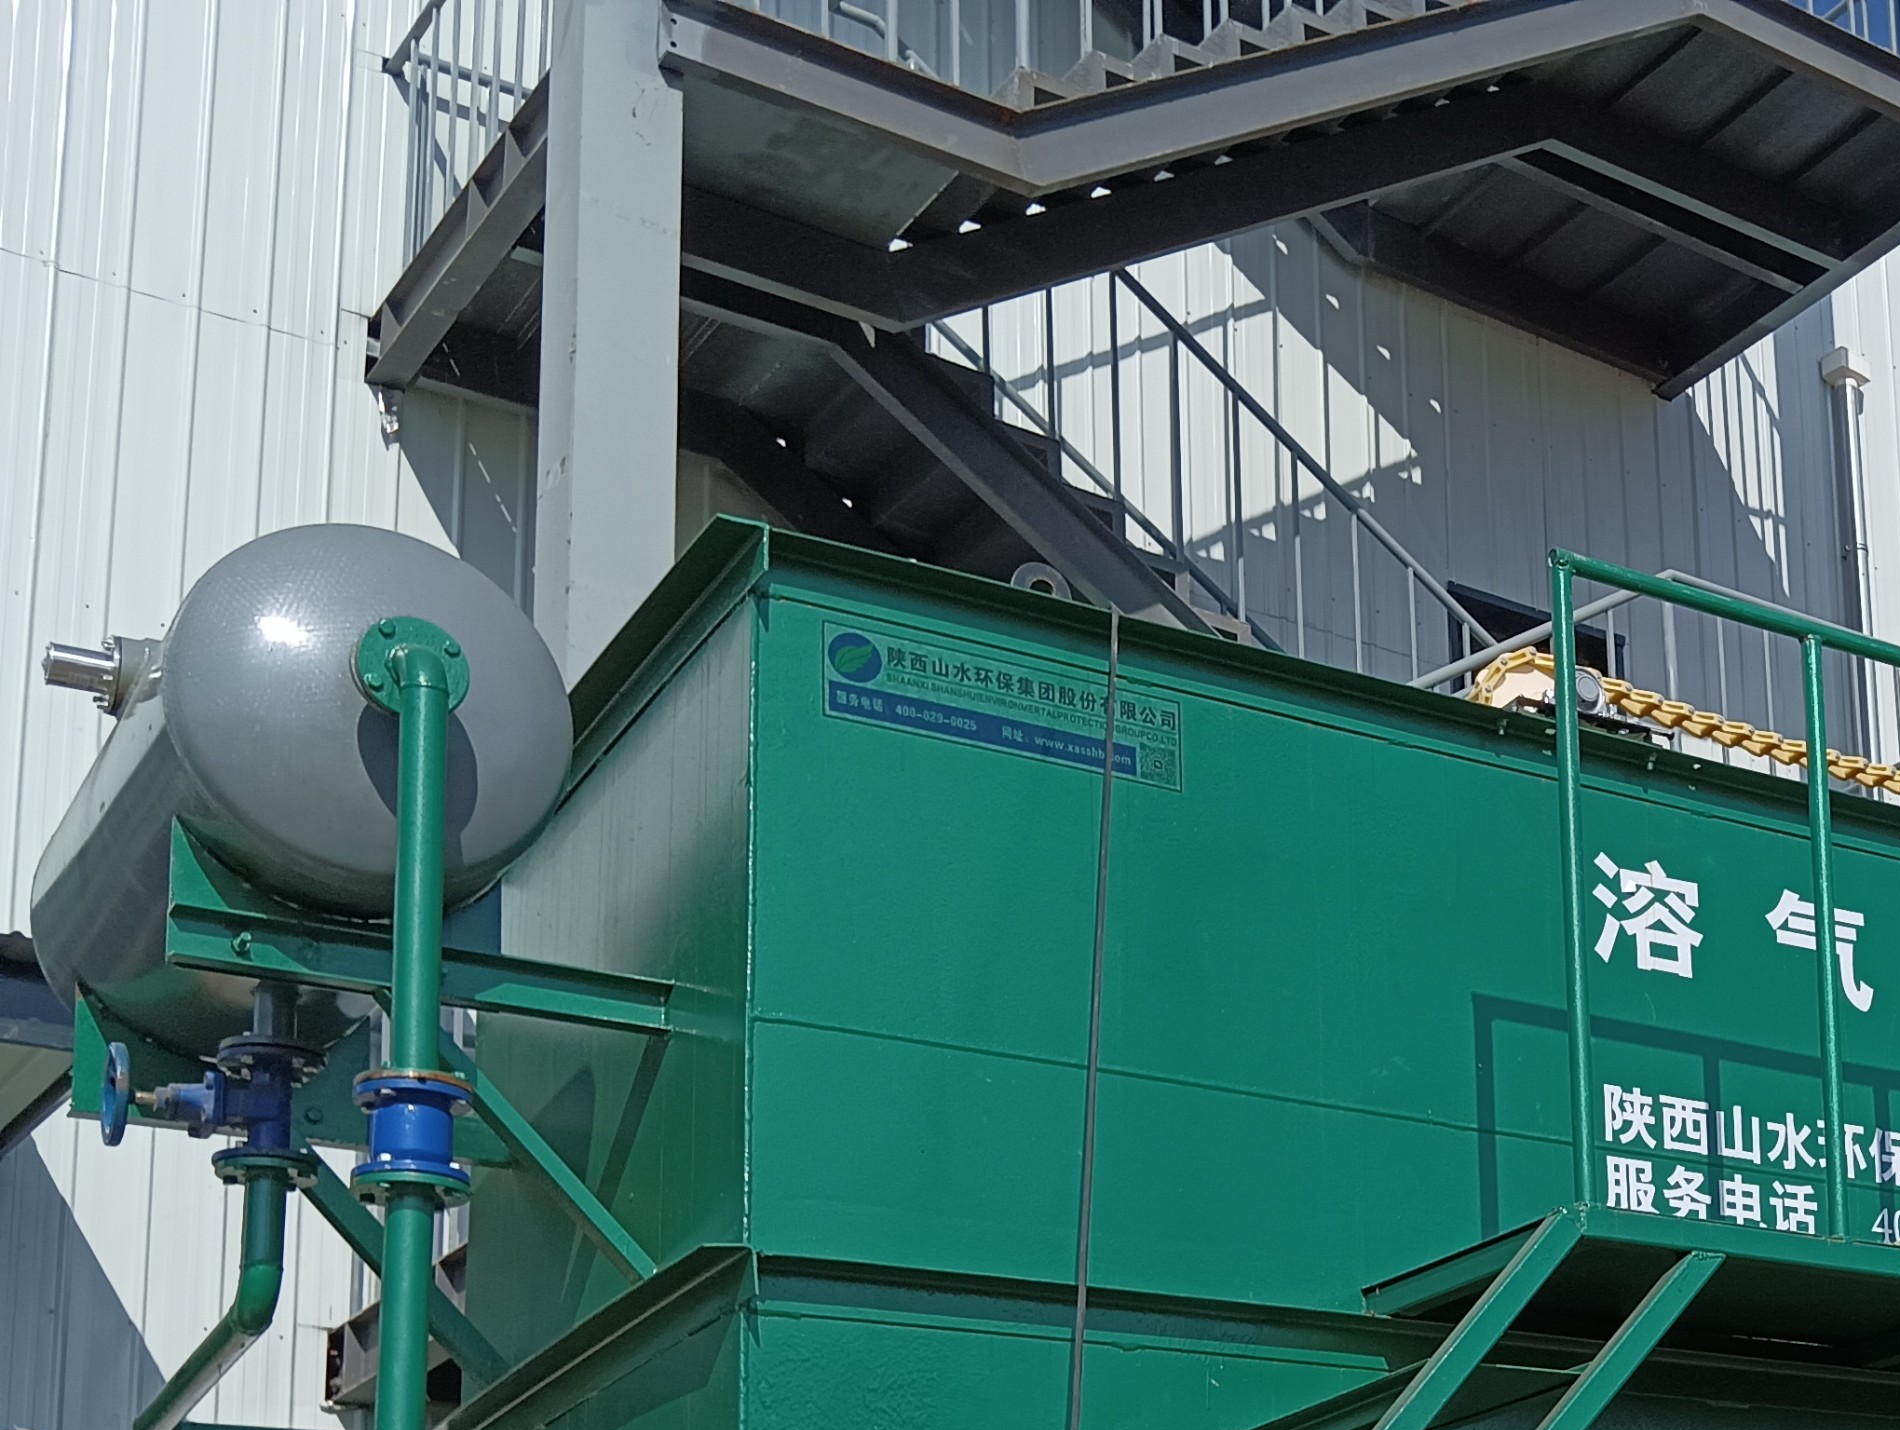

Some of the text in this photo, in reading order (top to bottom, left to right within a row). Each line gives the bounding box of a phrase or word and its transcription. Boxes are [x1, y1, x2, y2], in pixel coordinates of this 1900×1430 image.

[886, 645, 1176, 731] 陕西山水环保集团股份有限公司
[895, 704, 977, 732] 400-029-0025
[1606, 1155, 1818, 1236] 服务电话
